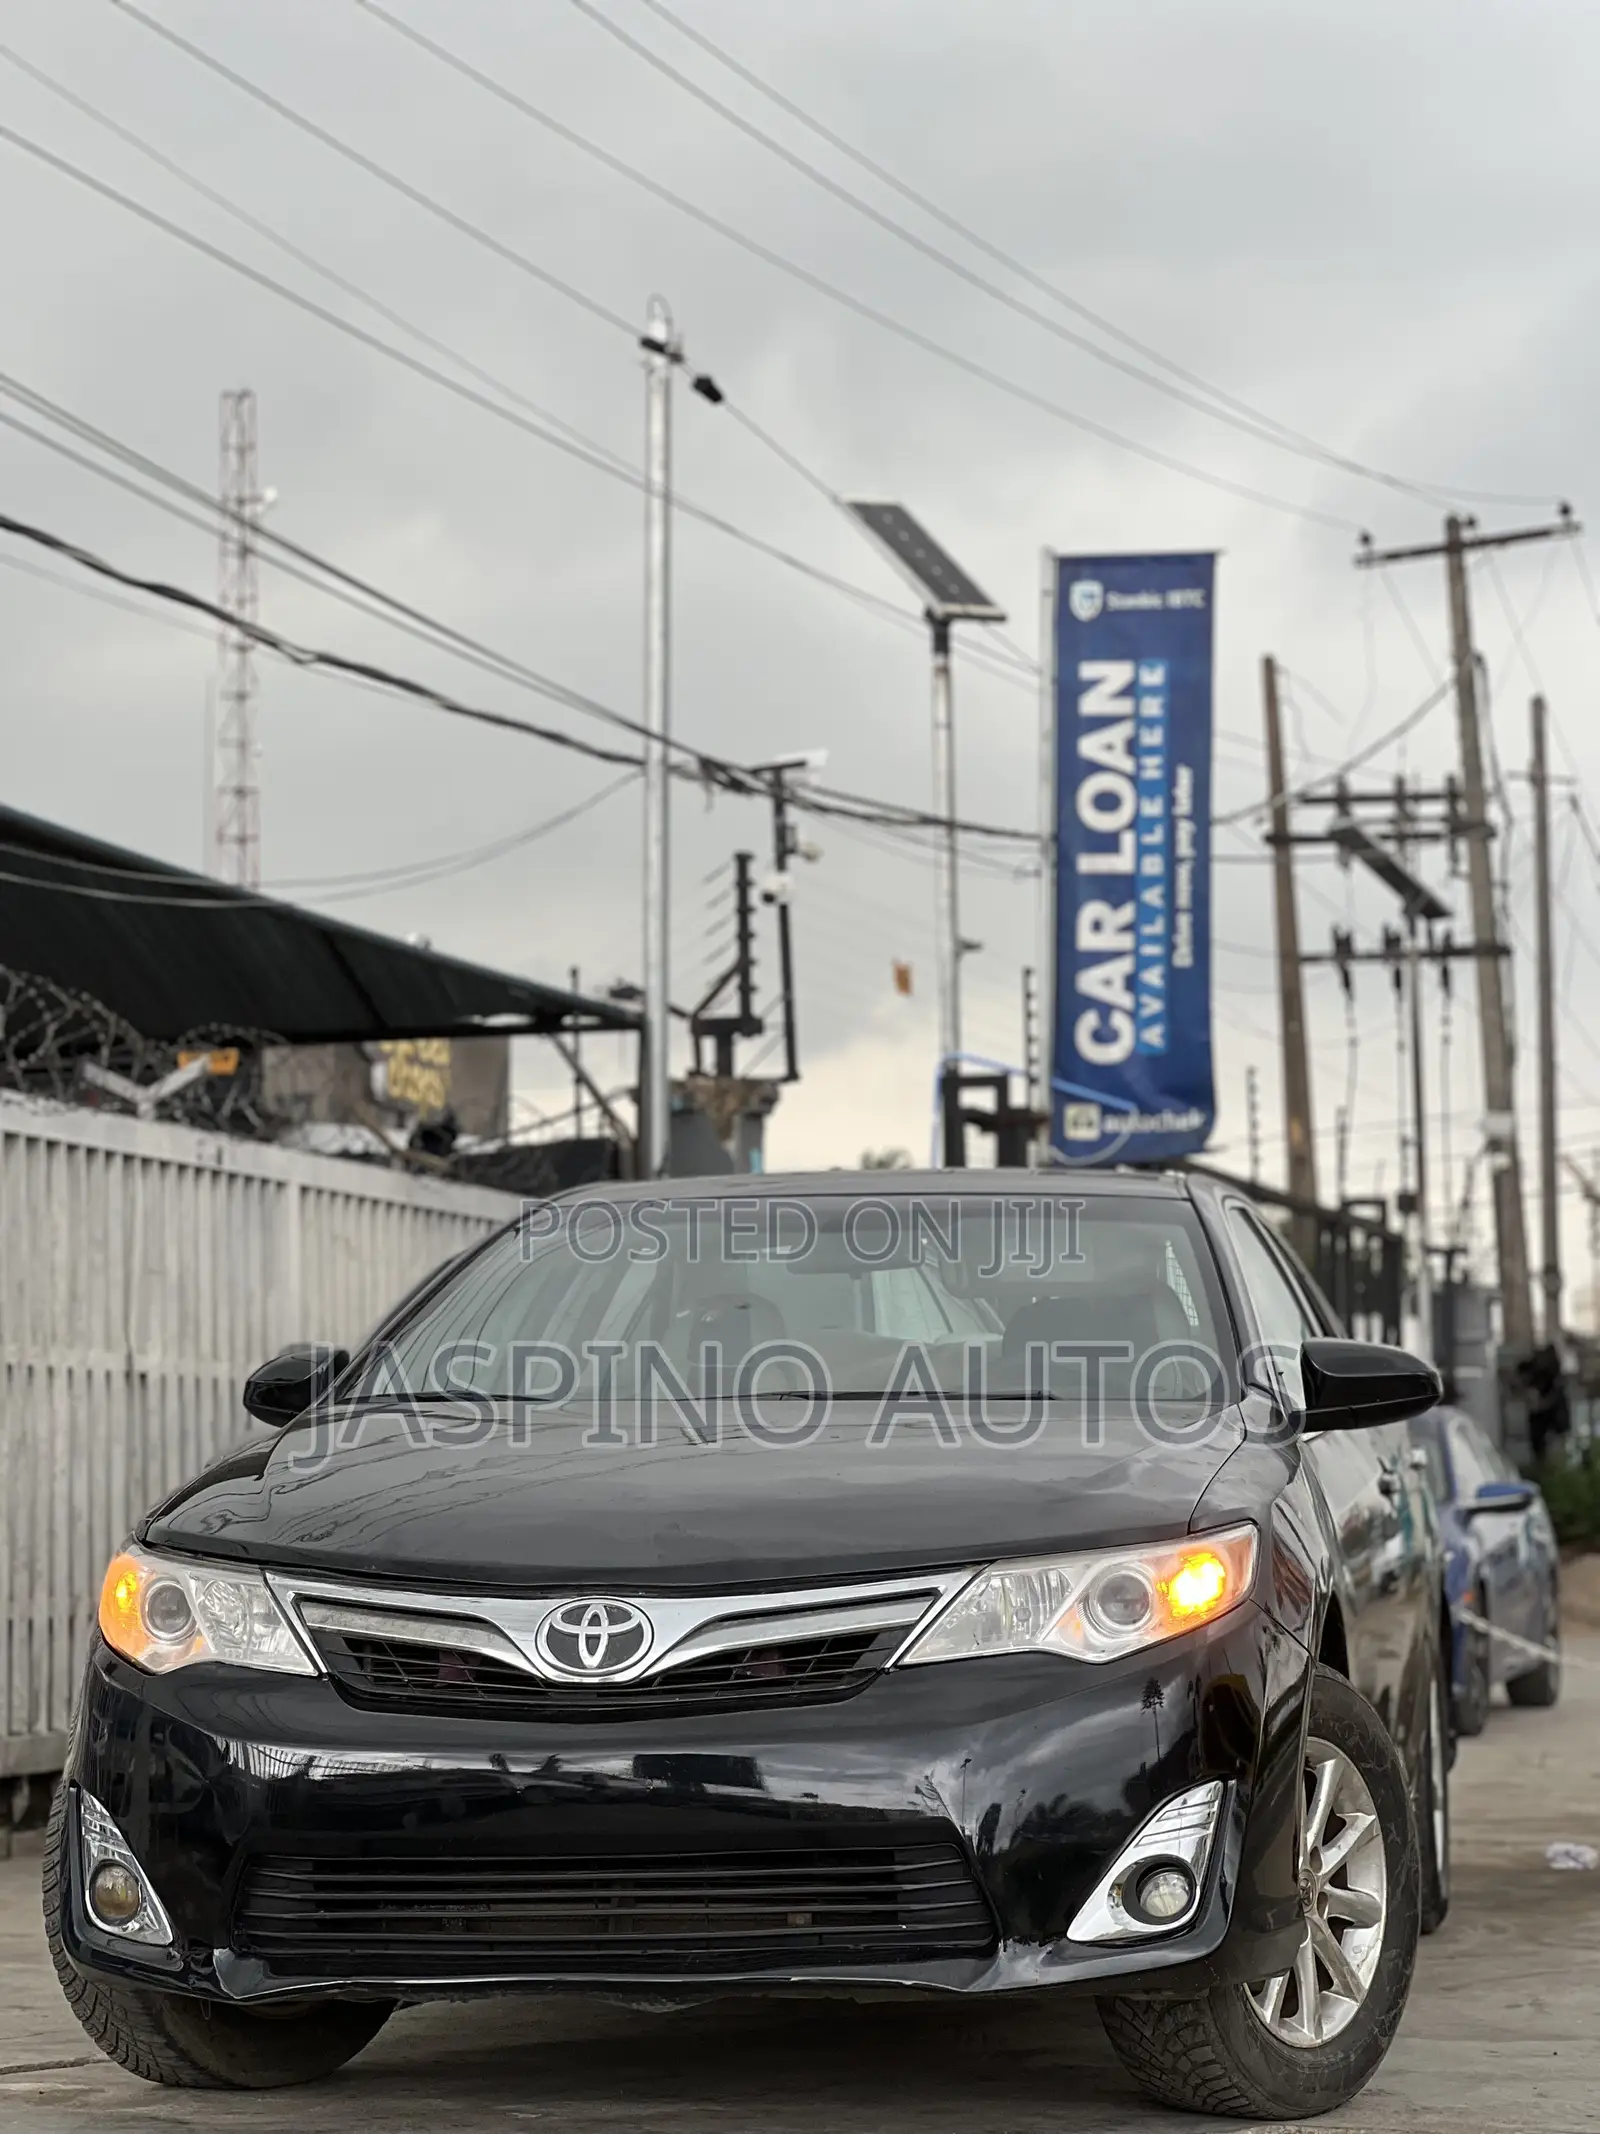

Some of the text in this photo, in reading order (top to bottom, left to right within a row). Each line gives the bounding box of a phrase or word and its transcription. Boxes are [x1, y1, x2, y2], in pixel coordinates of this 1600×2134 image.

[1074, 660, 1136, 1065] CAR LOAN
[1138, 664, 1165, 1049] AVAILABLE HERE
